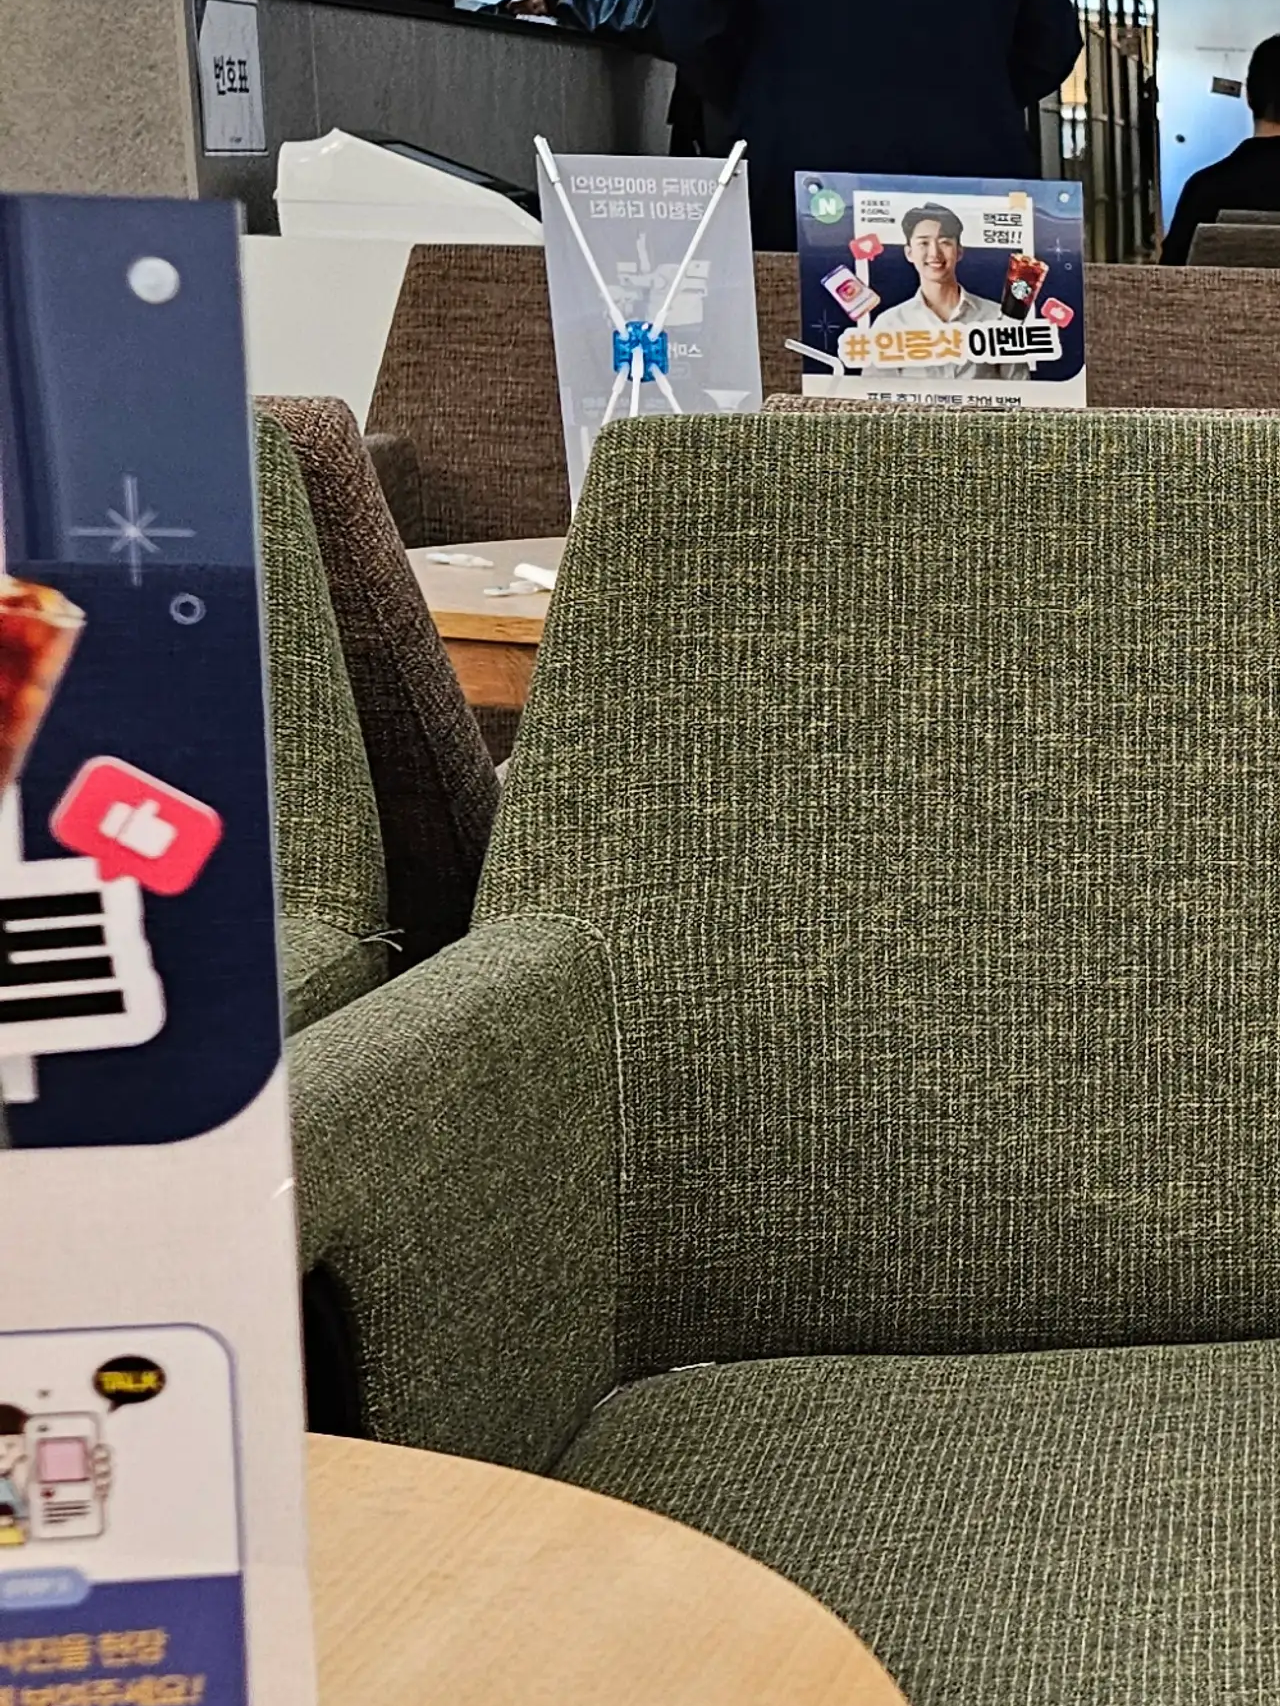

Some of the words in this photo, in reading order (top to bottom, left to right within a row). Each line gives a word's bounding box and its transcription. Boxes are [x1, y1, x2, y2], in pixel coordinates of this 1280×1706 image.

[213, 55, 250, 96] 번호표
[818, 199, 837, 216] N
[983, 229, 1023, 245] 당첨!!
[968, 325, 1054, 357] 이벤트
